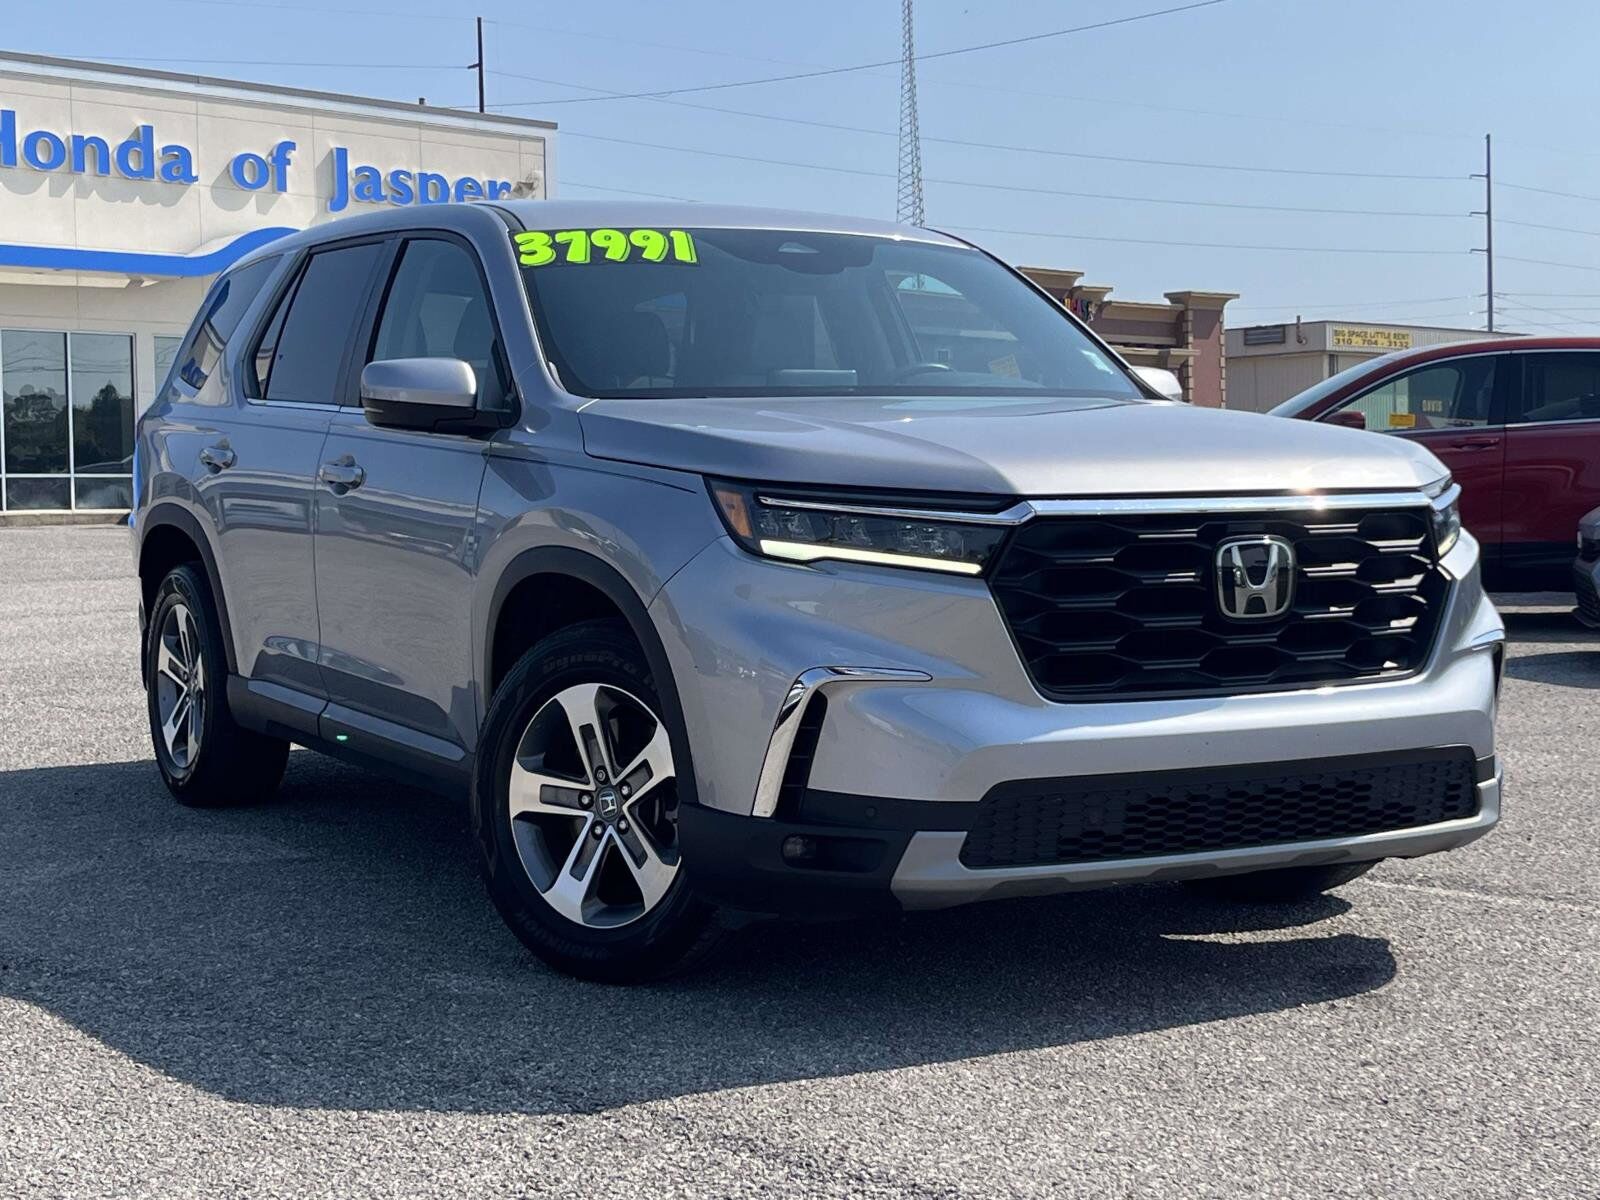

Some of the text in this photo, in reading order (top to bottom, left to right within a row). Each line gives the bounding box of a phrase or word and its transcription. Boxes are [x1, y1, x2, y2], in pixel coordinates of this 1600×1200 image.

[230, 140, 296, 193] of
[327, 147, 512, 213] Jasper
[514, 229, 697, 267] 37991
[1347, 330, 1368, 338] SPACE
[1369, 331, 1391, 339] LITTLE
